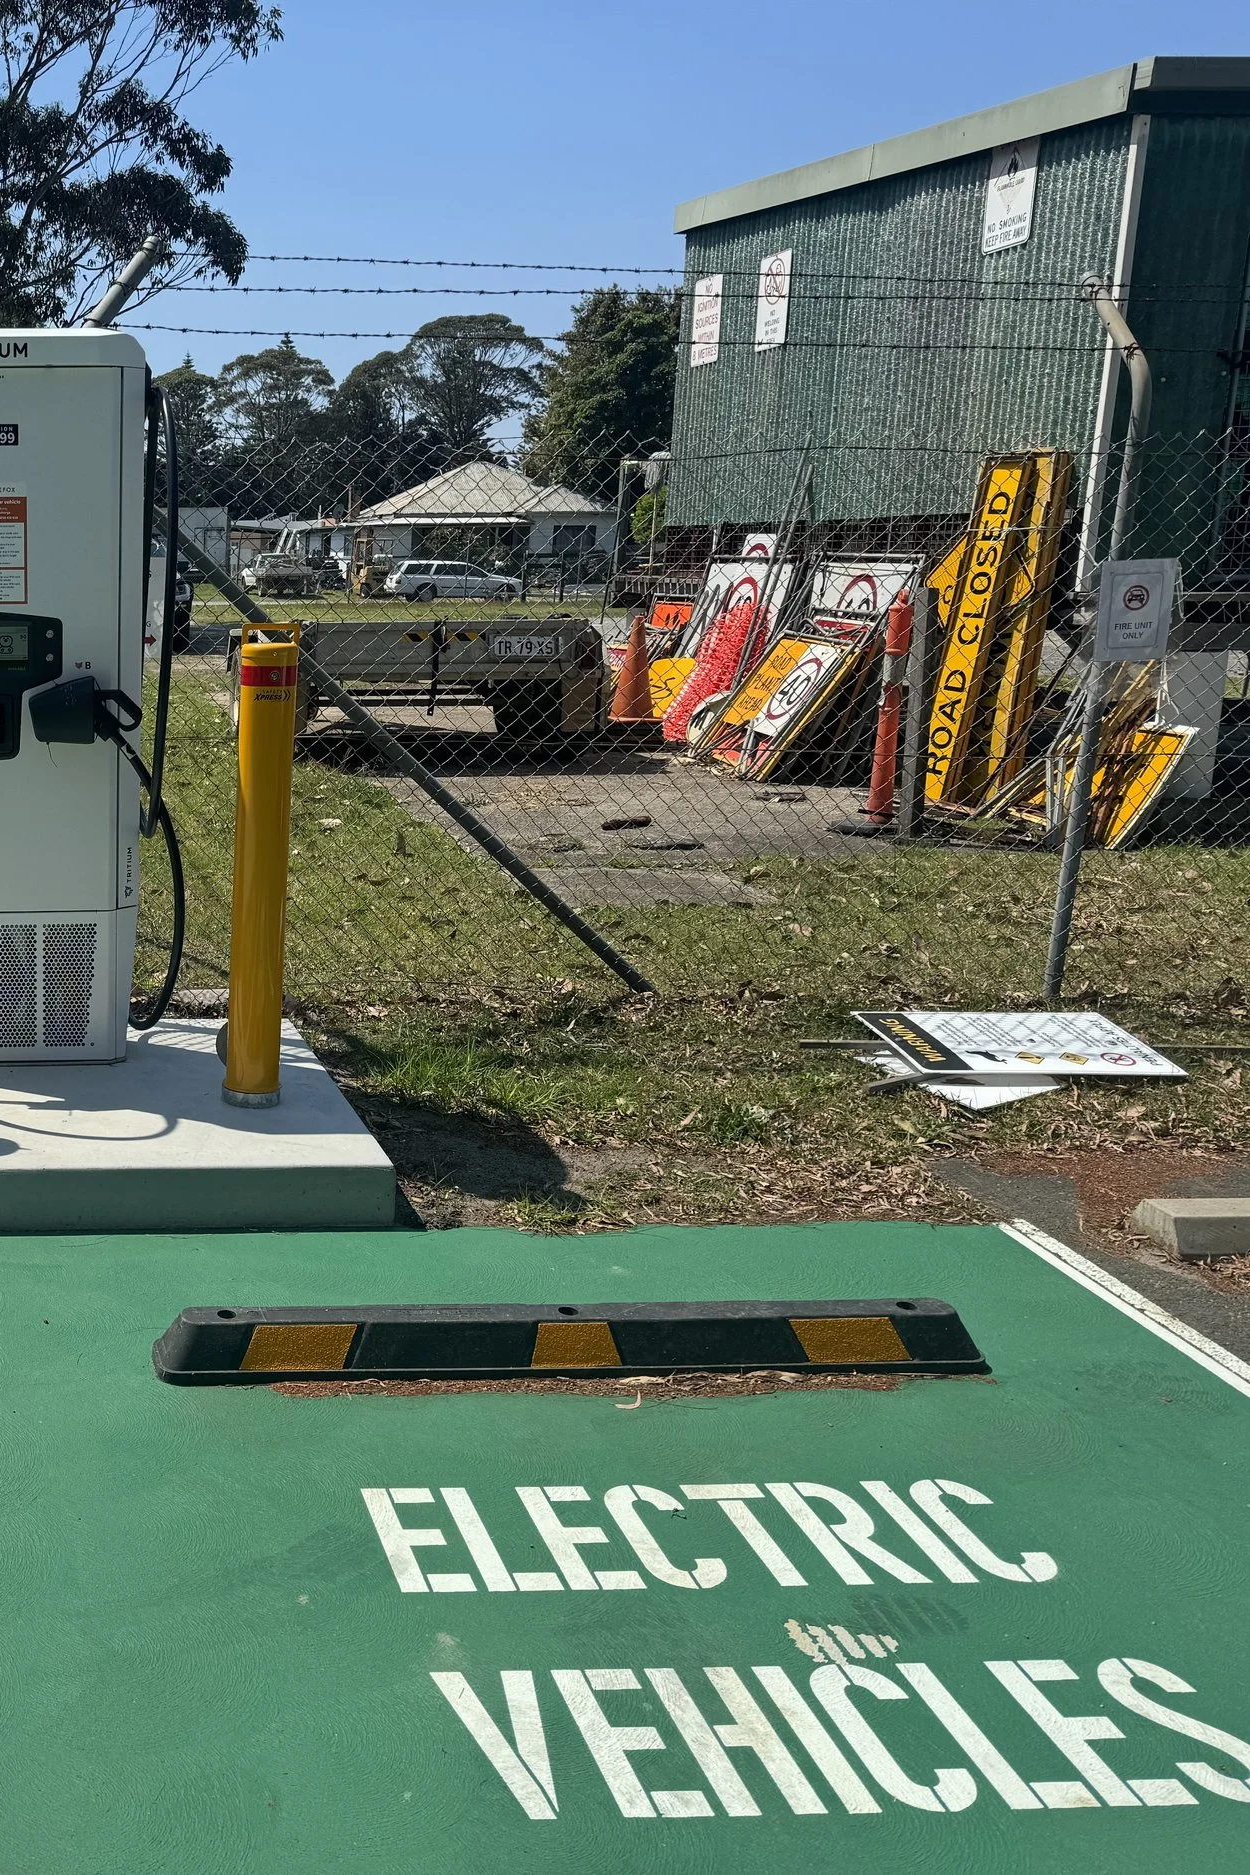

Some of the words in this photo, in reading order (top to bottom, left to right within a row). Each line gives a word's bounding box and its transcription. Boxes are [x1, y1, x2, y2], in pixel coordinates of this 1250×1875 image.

[987, 222, 996, 234] NO
[999, 212, 1027, 230] SMOKING
[985, 234, 999, 249] KEEP
[999, 229, 1013, 244] FIRE
[1012, 225, 1027, 239] AWAY
[695, 313, 719, 330] SOURCES
[698, 345, 717, 360] METRES
[926, 667, 967, 776] ROAD
[957, 490, 1013, 645] CLOSED
[1114, 622, 1132, 631] FIRE
[1134, 621, 1153, 629] UNIT
[1122, 632, 1144, 640] ONLY
[85, 661, 91, 670] B
[769, 655, 792, 671] ROAD
[254, 693, 283, 702] XPRESS
[779, 674, 812, 706] 40
[879, 1018, 947, 1062] WARNING
[360, 1479, 1058, 1593] ELECTRIC
[429, 1656, 1250, 1820] VEHICLES
